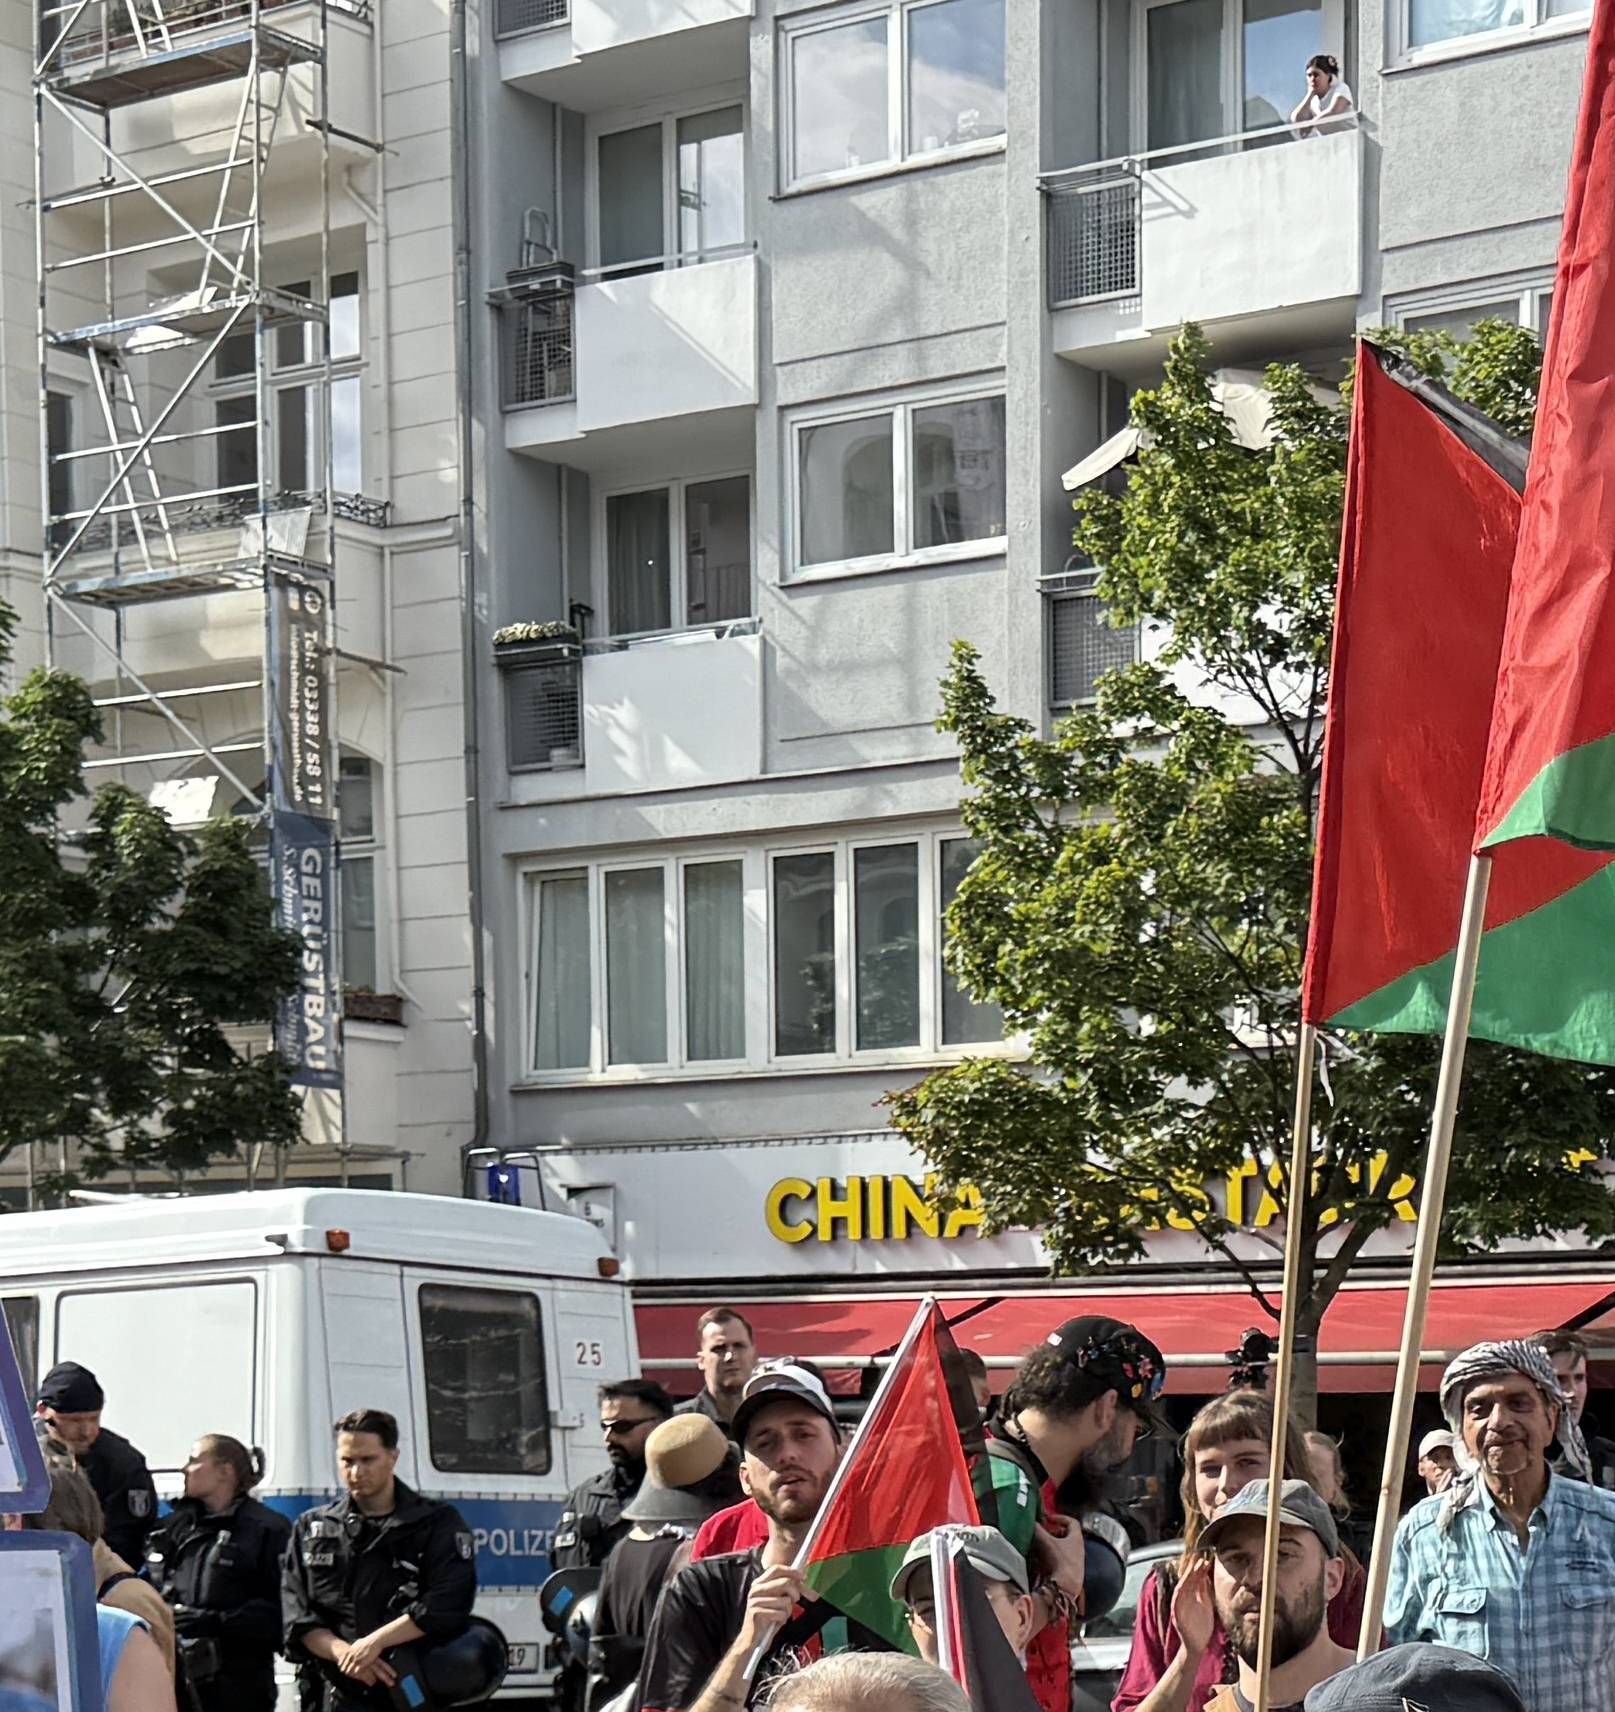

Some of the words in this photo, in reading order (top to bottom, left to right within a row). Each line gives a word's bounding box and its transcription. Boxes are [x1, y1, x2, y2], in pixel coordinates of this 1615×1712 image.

[301, 847, 328, 1070] GERÜSTBAU
[765, 1173, 986, 1243] CHINA
[576, 1342, 601, 1366] 25
